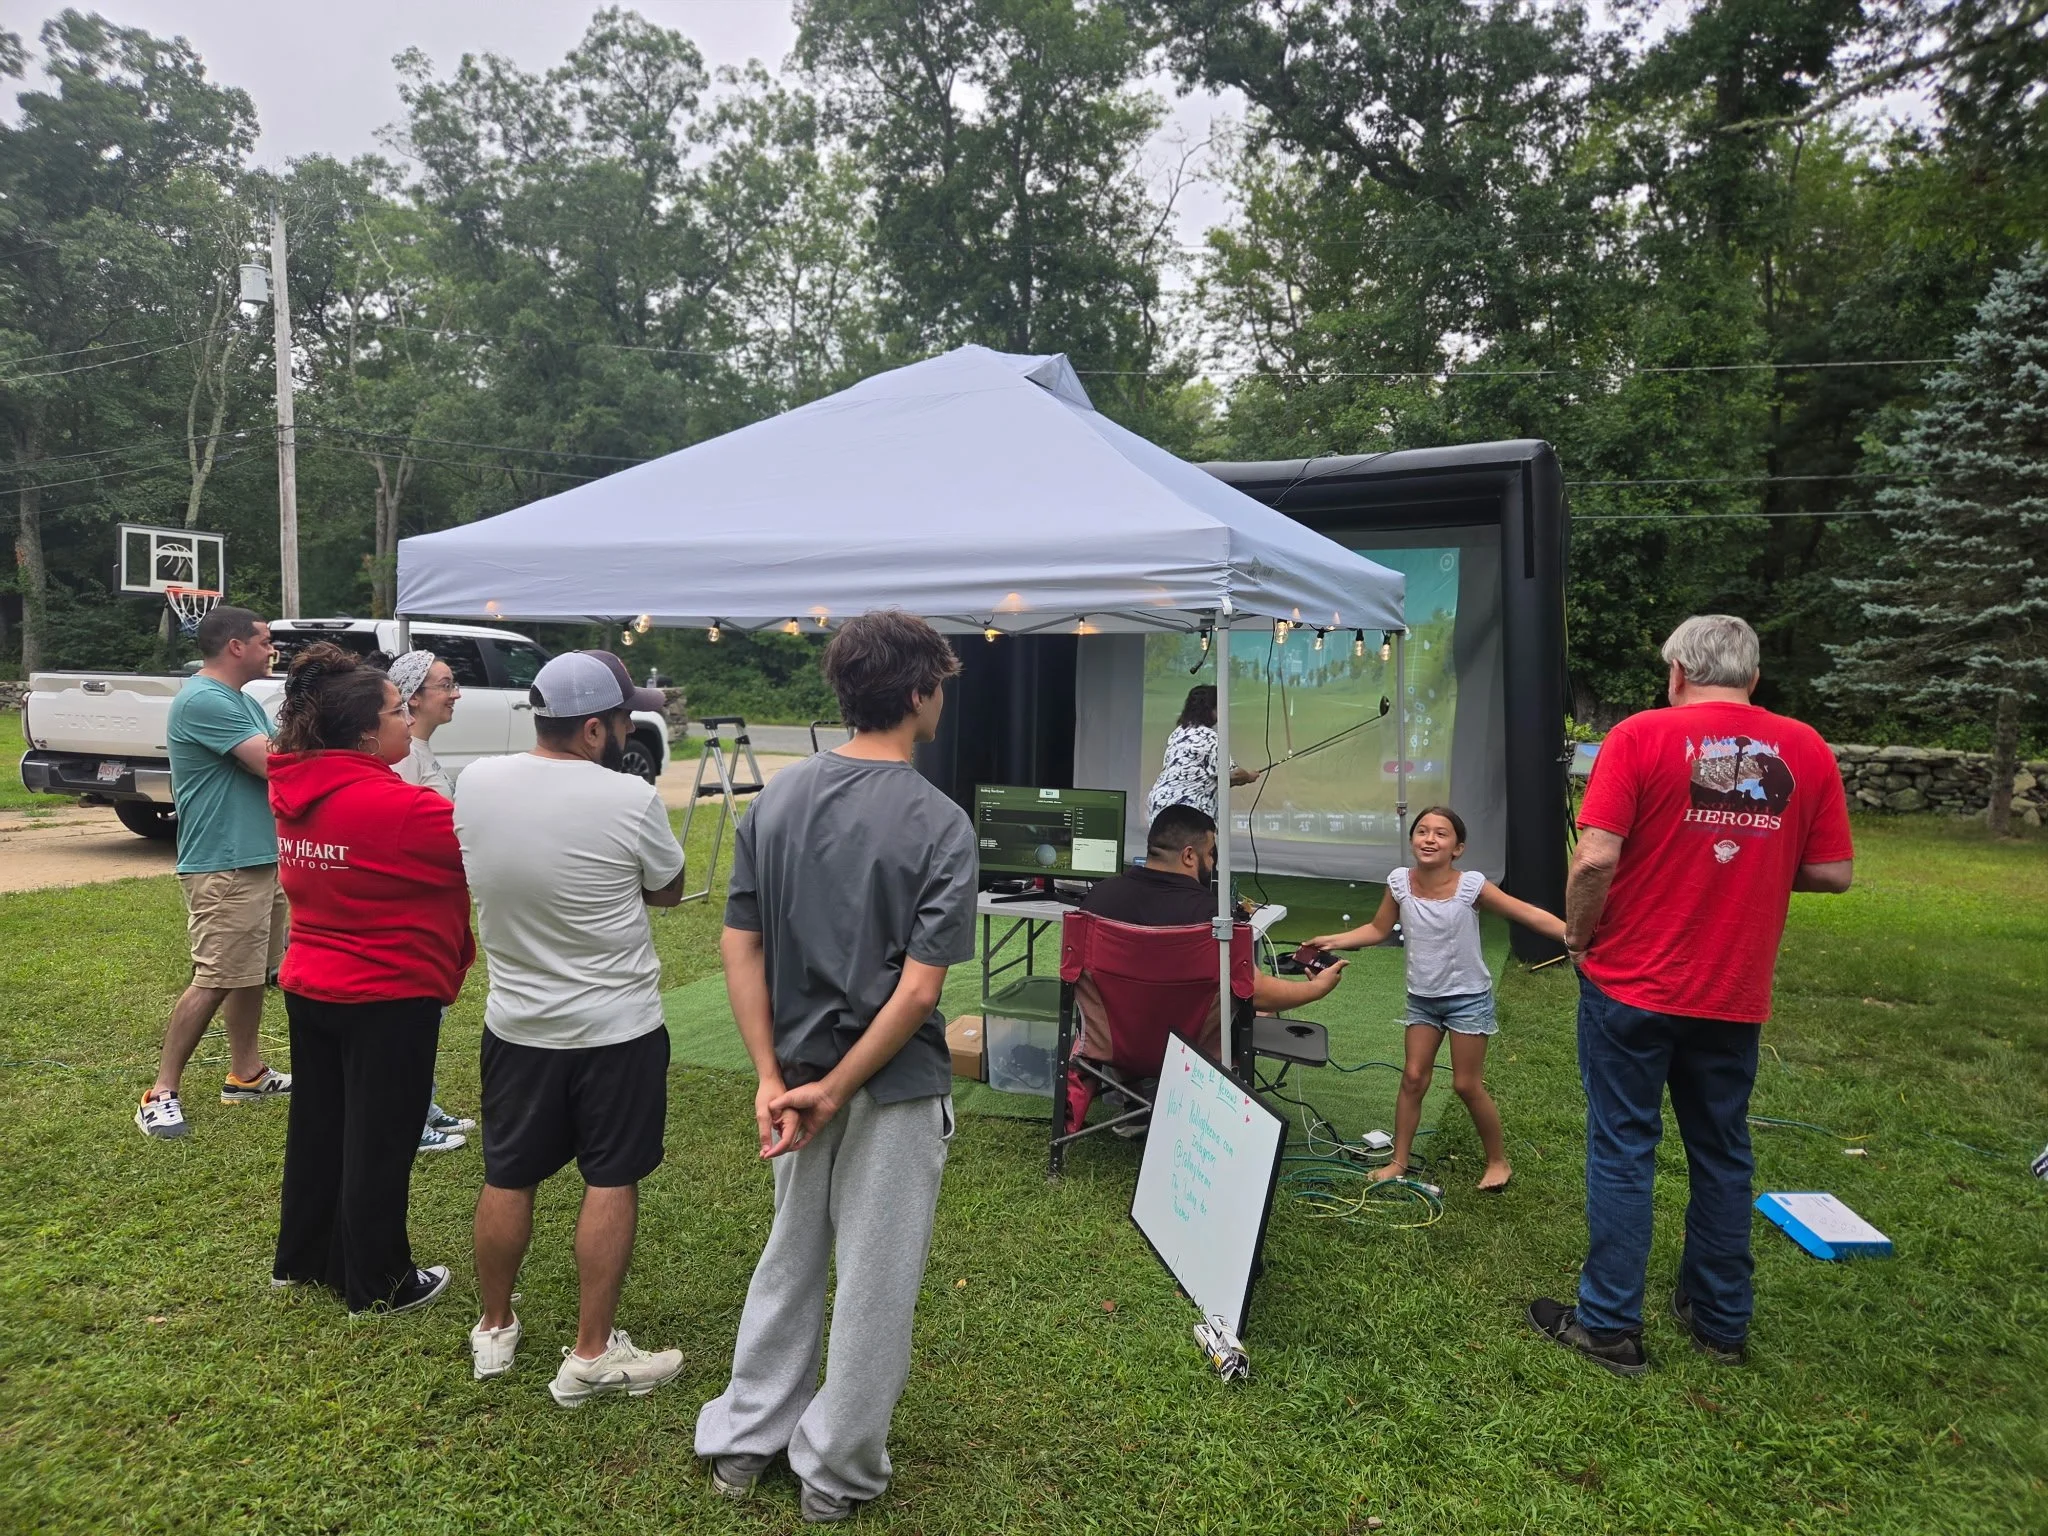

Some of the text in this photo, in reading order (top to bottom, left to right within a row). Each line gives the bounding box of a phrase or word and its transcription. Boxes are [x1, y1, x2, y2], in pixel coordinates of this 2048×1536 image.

[54, 713, 141, 732] TUNDRA
[1683, 808, 1782, 830] HEROES
[296, 838, 349, 861] HEART
